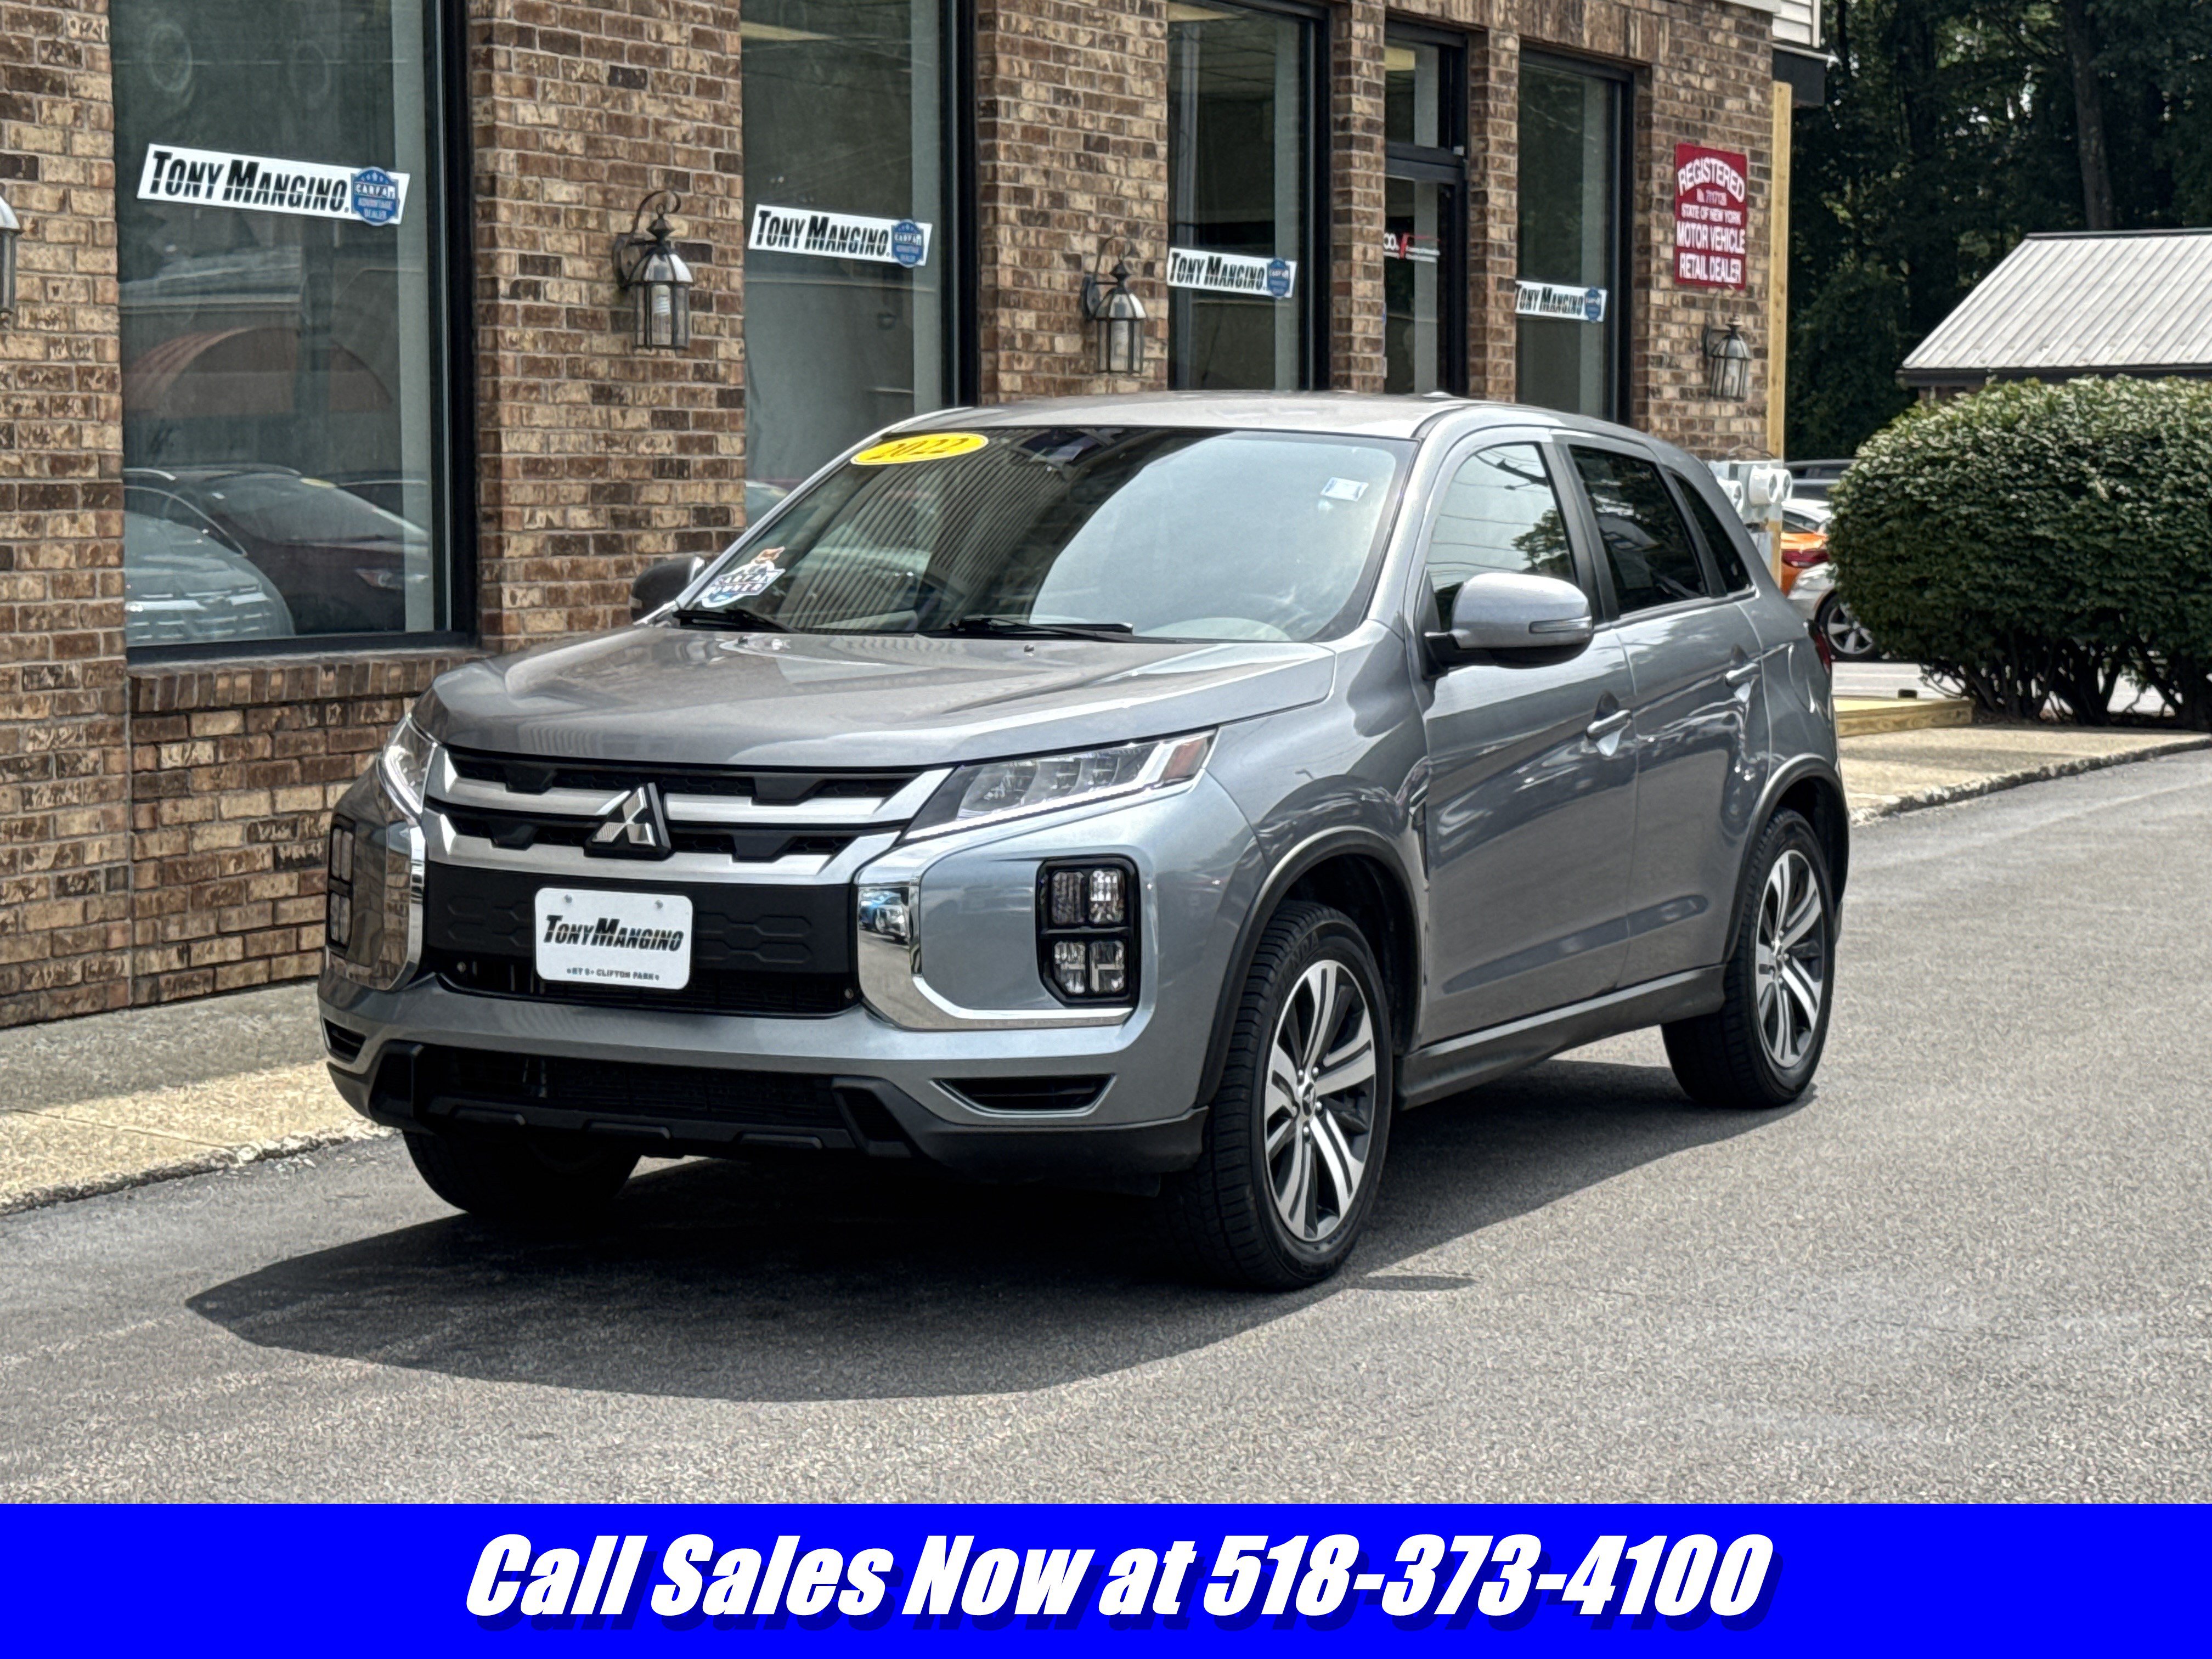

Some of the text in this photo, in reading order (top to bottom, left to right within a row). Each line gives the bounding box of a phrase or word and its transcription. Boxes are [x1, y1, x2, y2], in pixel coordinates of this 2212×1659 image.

[149, 150, 224, 200] TONY
[1677, 156, 1745, 202] REGISTERED
[755, 210, 806, 249] TONY
[1677, 221, 1745, 255] MOTOR VEHICLE
[1170, 252, 1205, 285] TONY
[1679, 252, 1741, 284] RETAIL DEALER
[866, 437, 970, 460] 2022
[596, 968, 630, 978] CLIFTON
[633, 972, 653, 980] PARK
